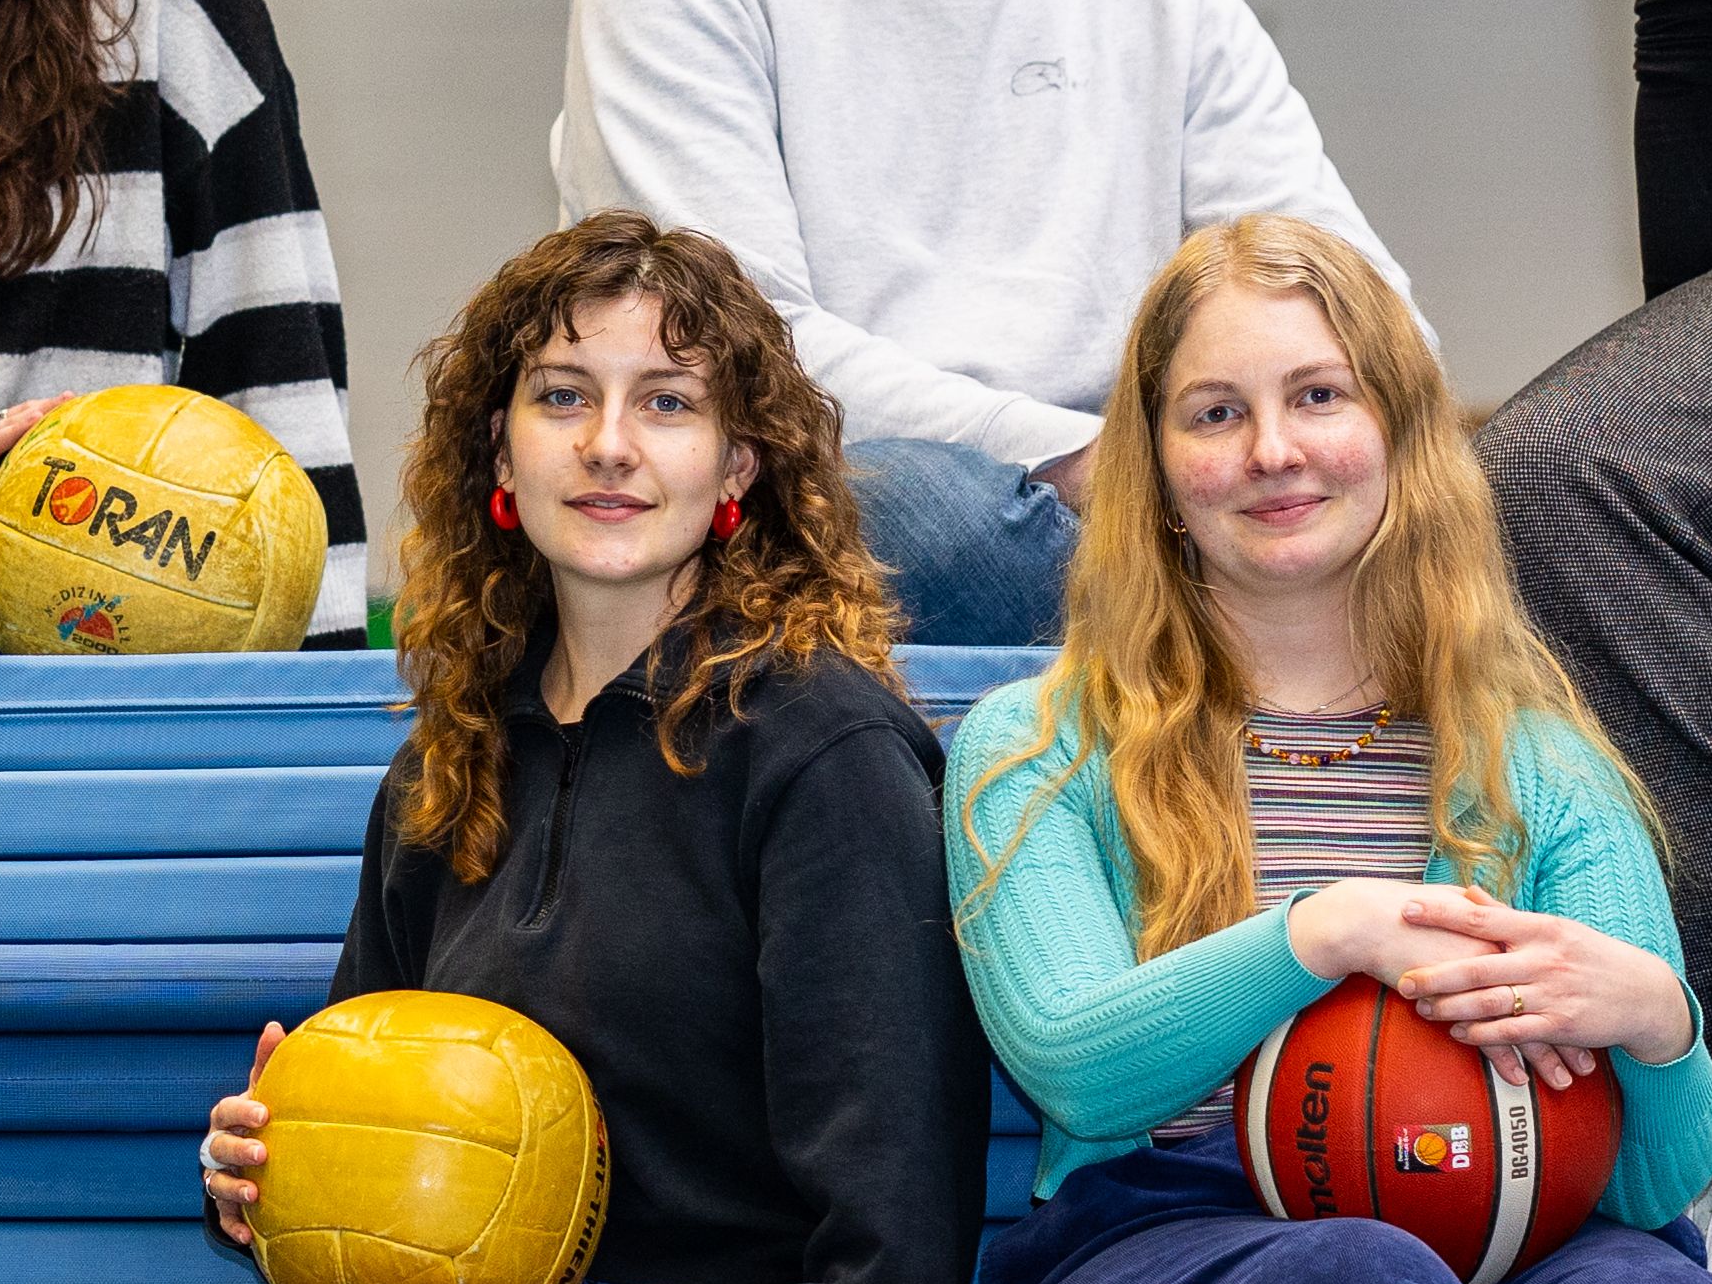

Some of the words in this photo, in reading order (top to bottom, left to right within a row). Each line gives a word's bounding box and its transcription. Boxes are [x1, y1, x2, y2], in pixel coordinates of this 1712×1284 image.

[32, 456, 216, 581] TORAN
[1296, 1061, 1339, 1219] molten
[1451, 1125, 1471, 1169] DBB
[1509, 1105, 1529, 1180] BG4050
